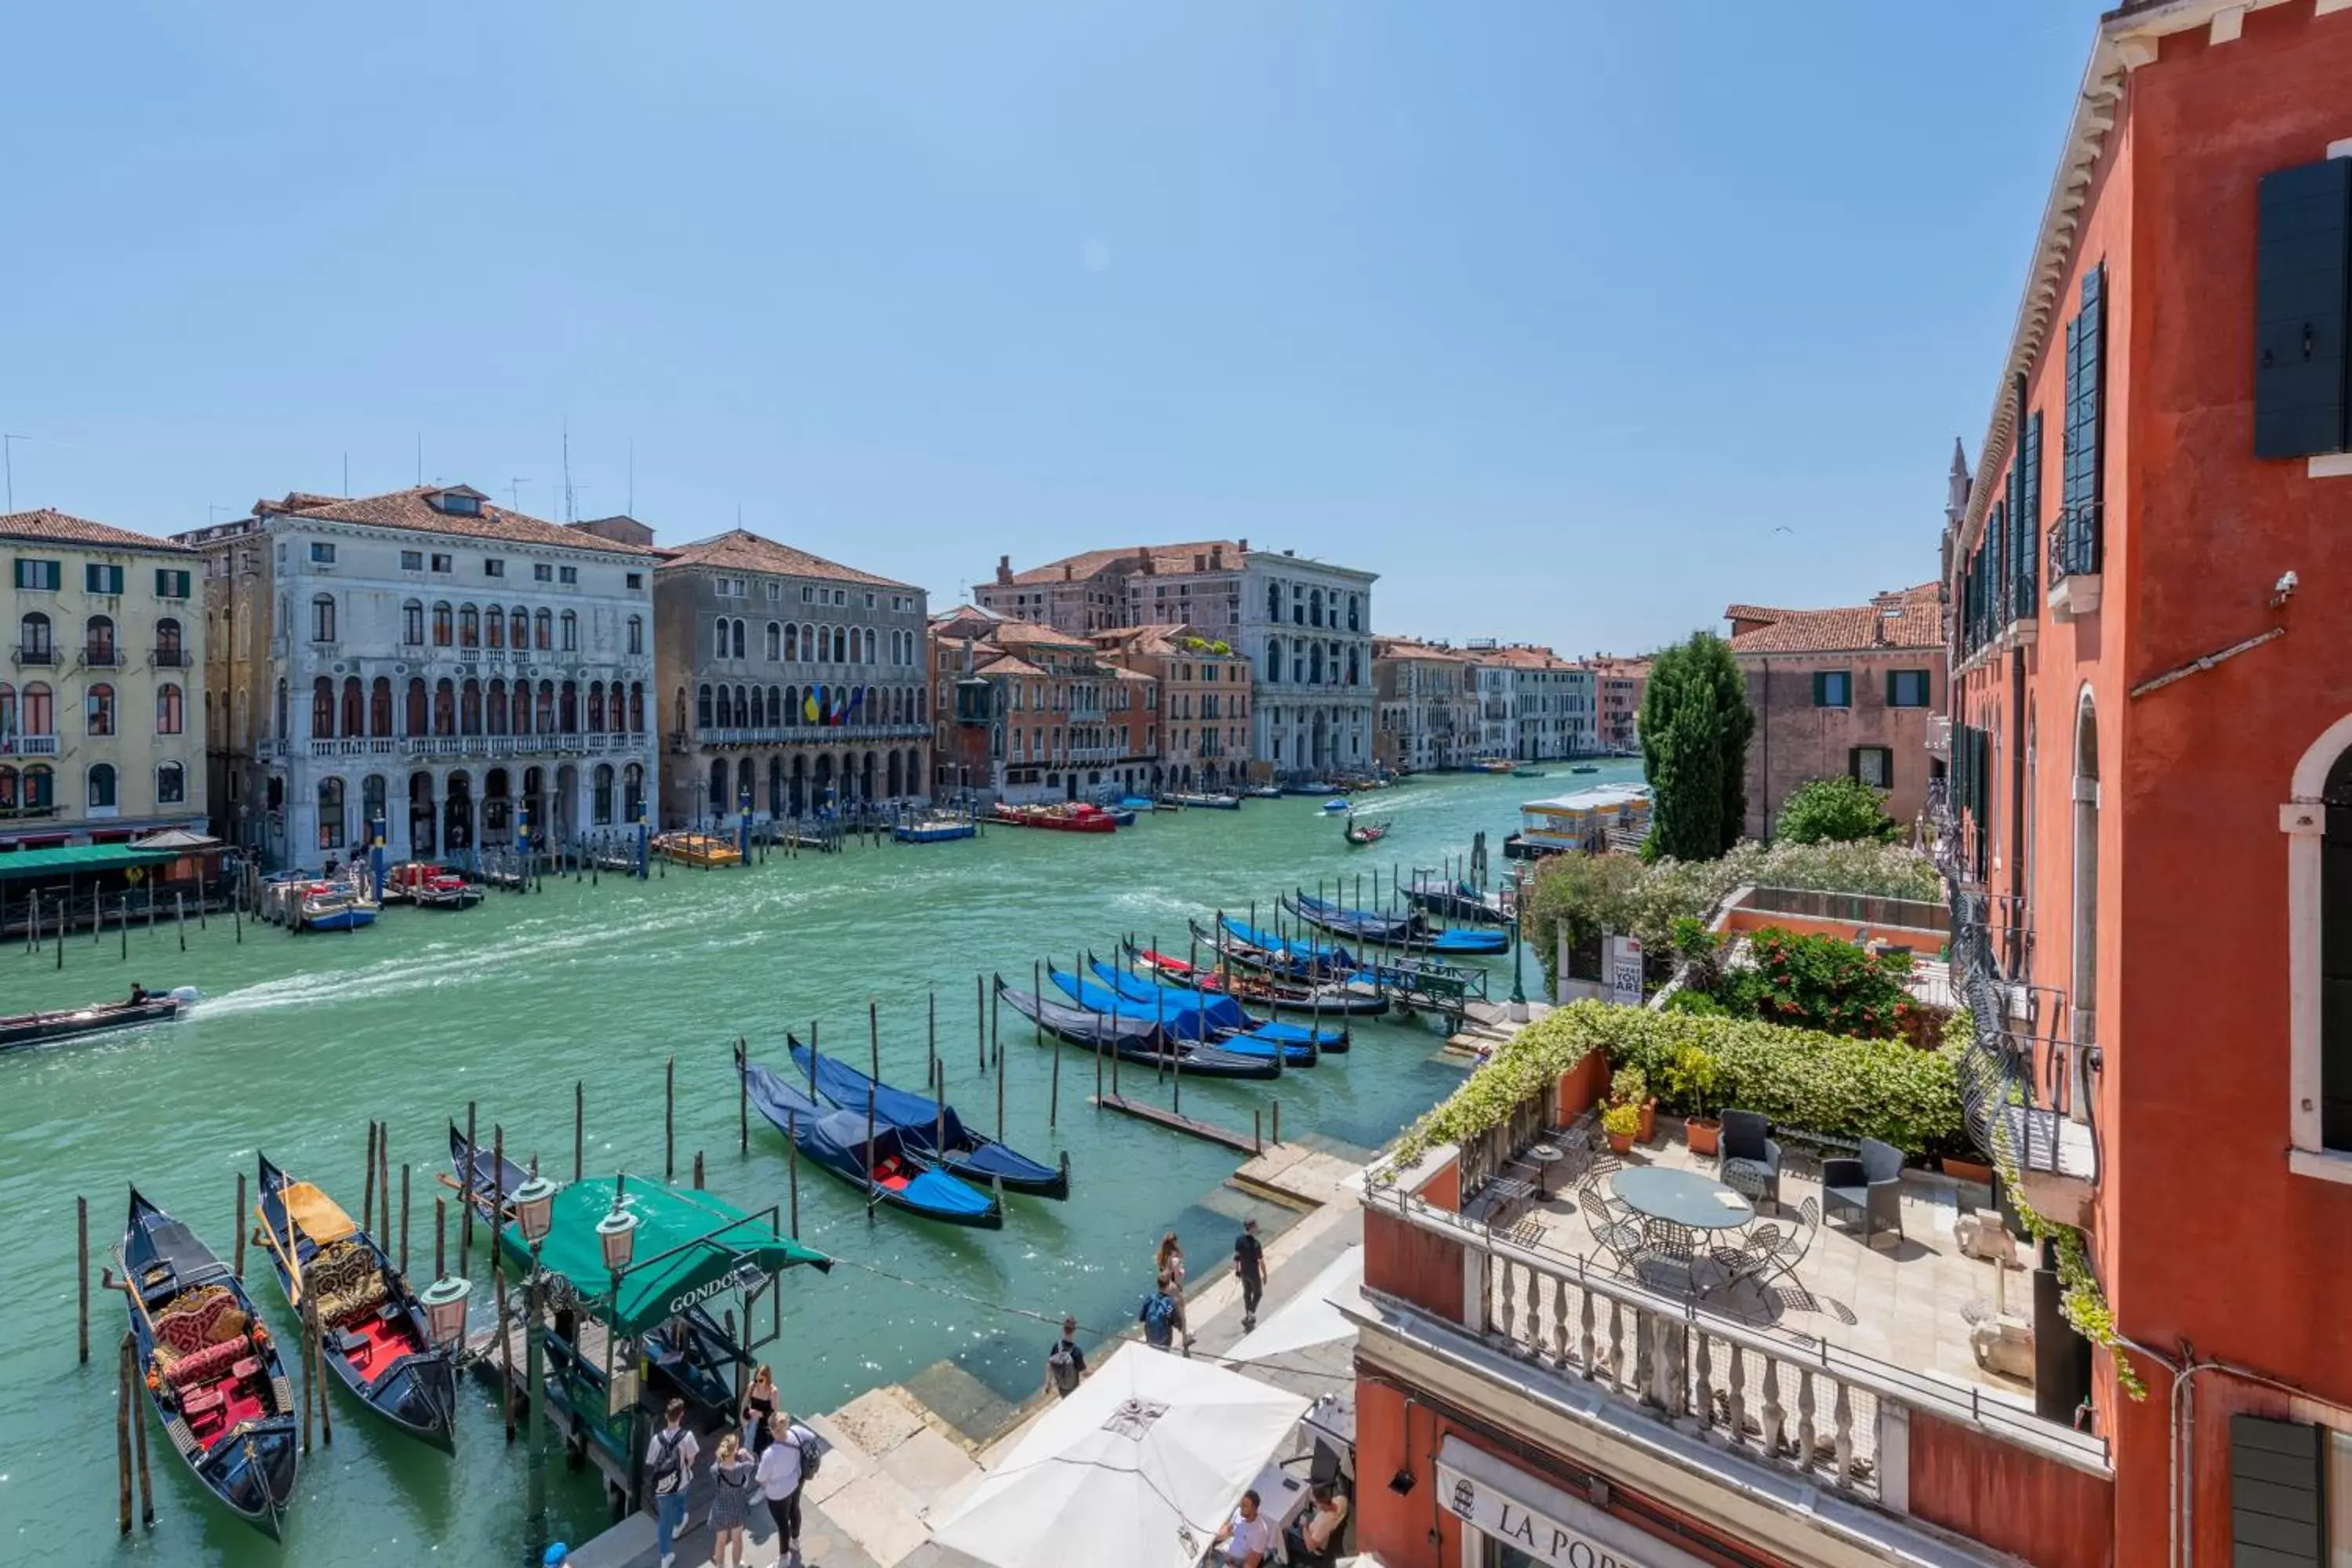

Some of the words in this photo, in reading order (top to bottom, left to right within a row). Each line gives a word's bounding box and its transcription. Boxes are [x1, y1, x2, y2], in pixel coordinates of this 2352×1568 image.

[1616, 981, 1641, 993] ARE
[1617, 973, 1640, 983] YOU
[670, 1269, 739, 1313] GONDO
[1498, 1503, 1535, 1548] LA
[1550, 1528, 1631, 1568] PO
